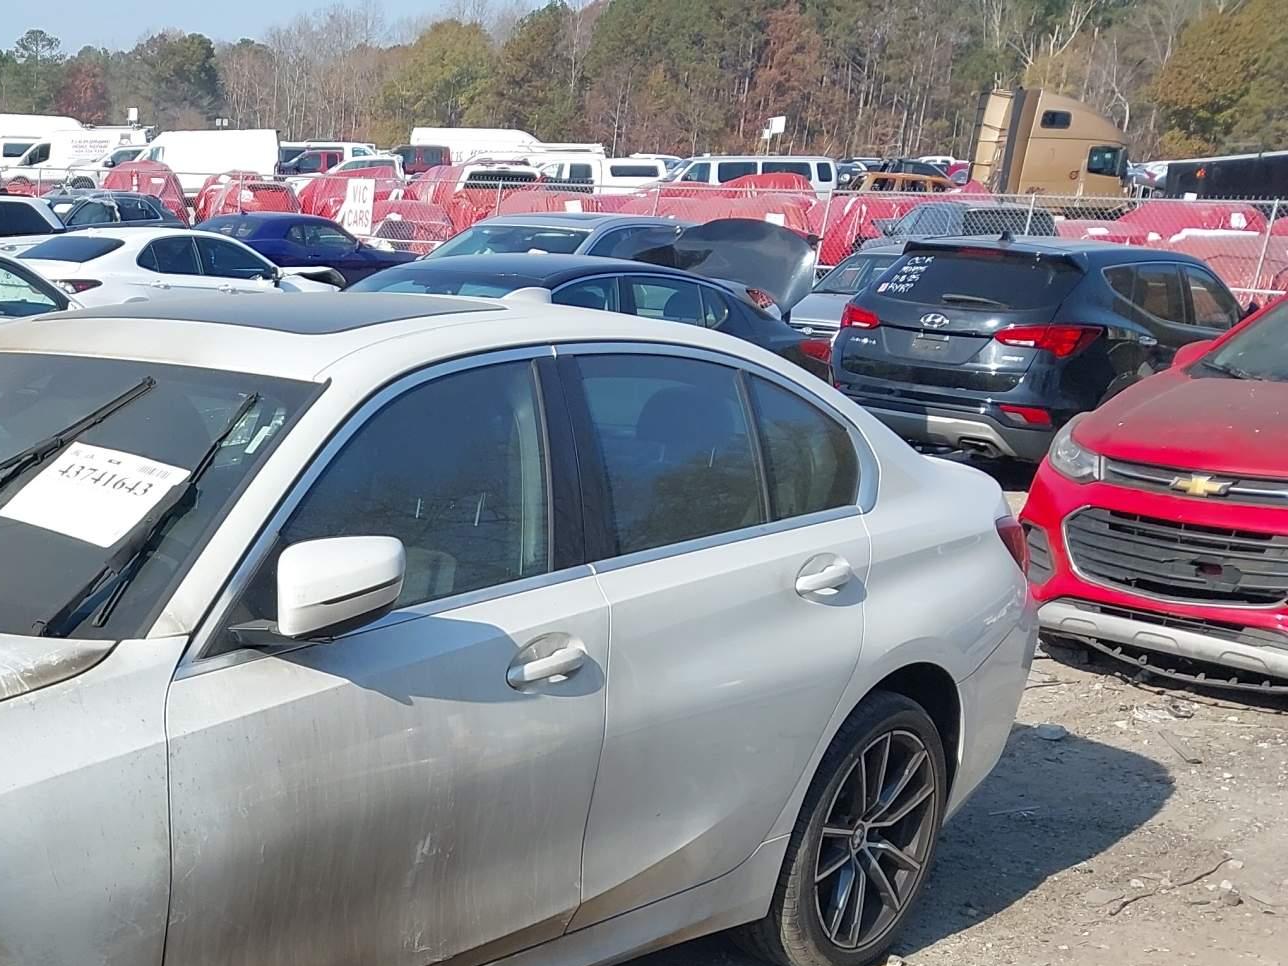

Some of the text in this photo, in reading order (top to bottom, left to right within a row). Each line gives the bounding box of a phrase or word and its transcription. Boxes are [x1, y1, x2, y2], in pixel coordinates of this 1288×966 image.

[353, 184, 369, 204] VIC
[346, 208, 370, 228] CARS
[58, 463, 154, 496] 43741643
